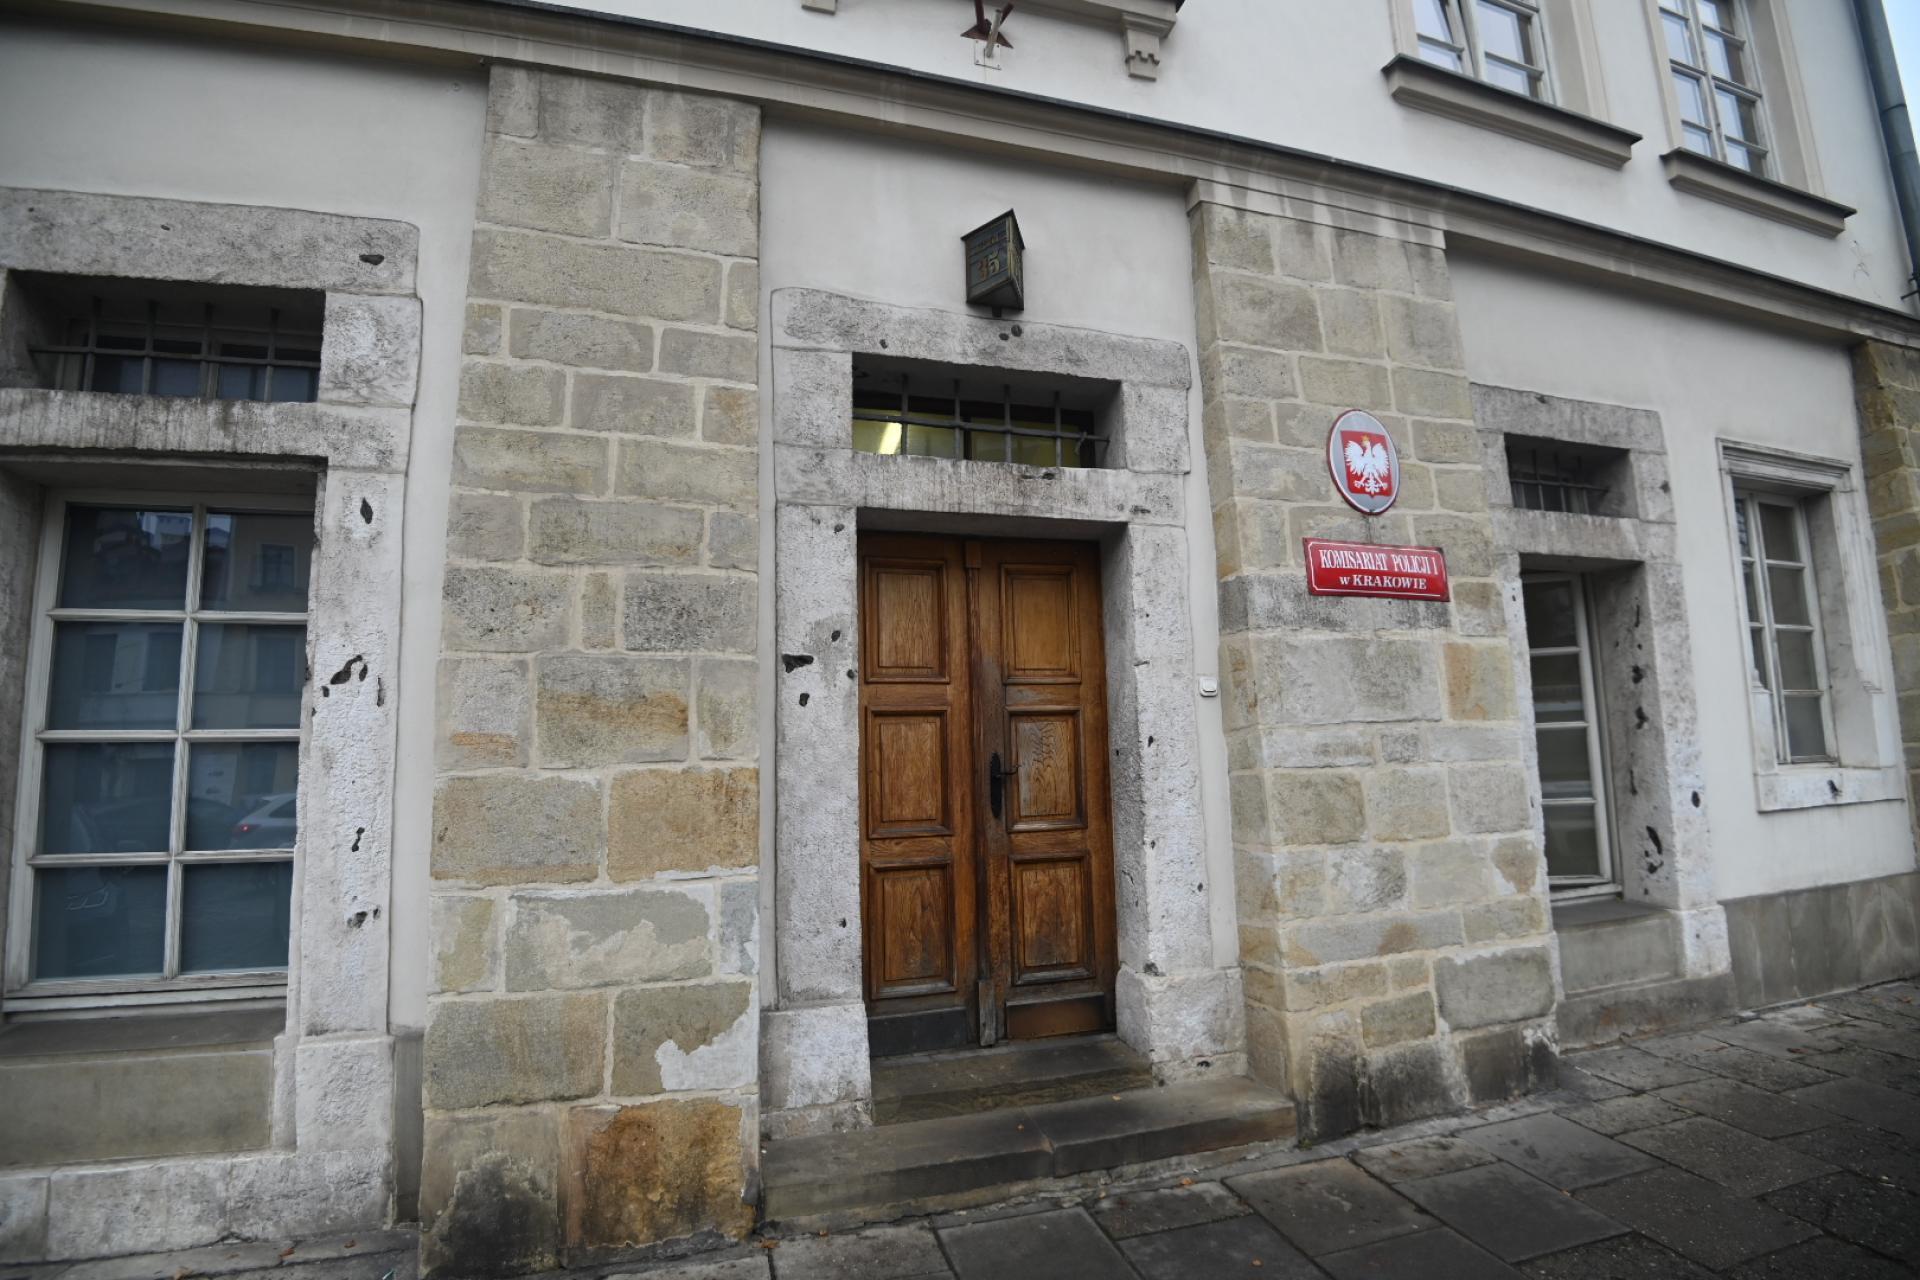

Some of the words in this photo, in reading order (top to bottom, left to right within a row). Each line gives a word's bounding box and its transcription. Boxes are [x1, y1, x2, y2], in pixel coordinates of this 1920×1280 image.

[1319, 549, 1388, 571] KOMISARIAT
[1391, 554, 1430, 575] POLICJI
[1431, 557, 1439, 576] I
[1339, 576, 1350, 586] w
[1352, 574, 1427, 590] KRAKOWIE
